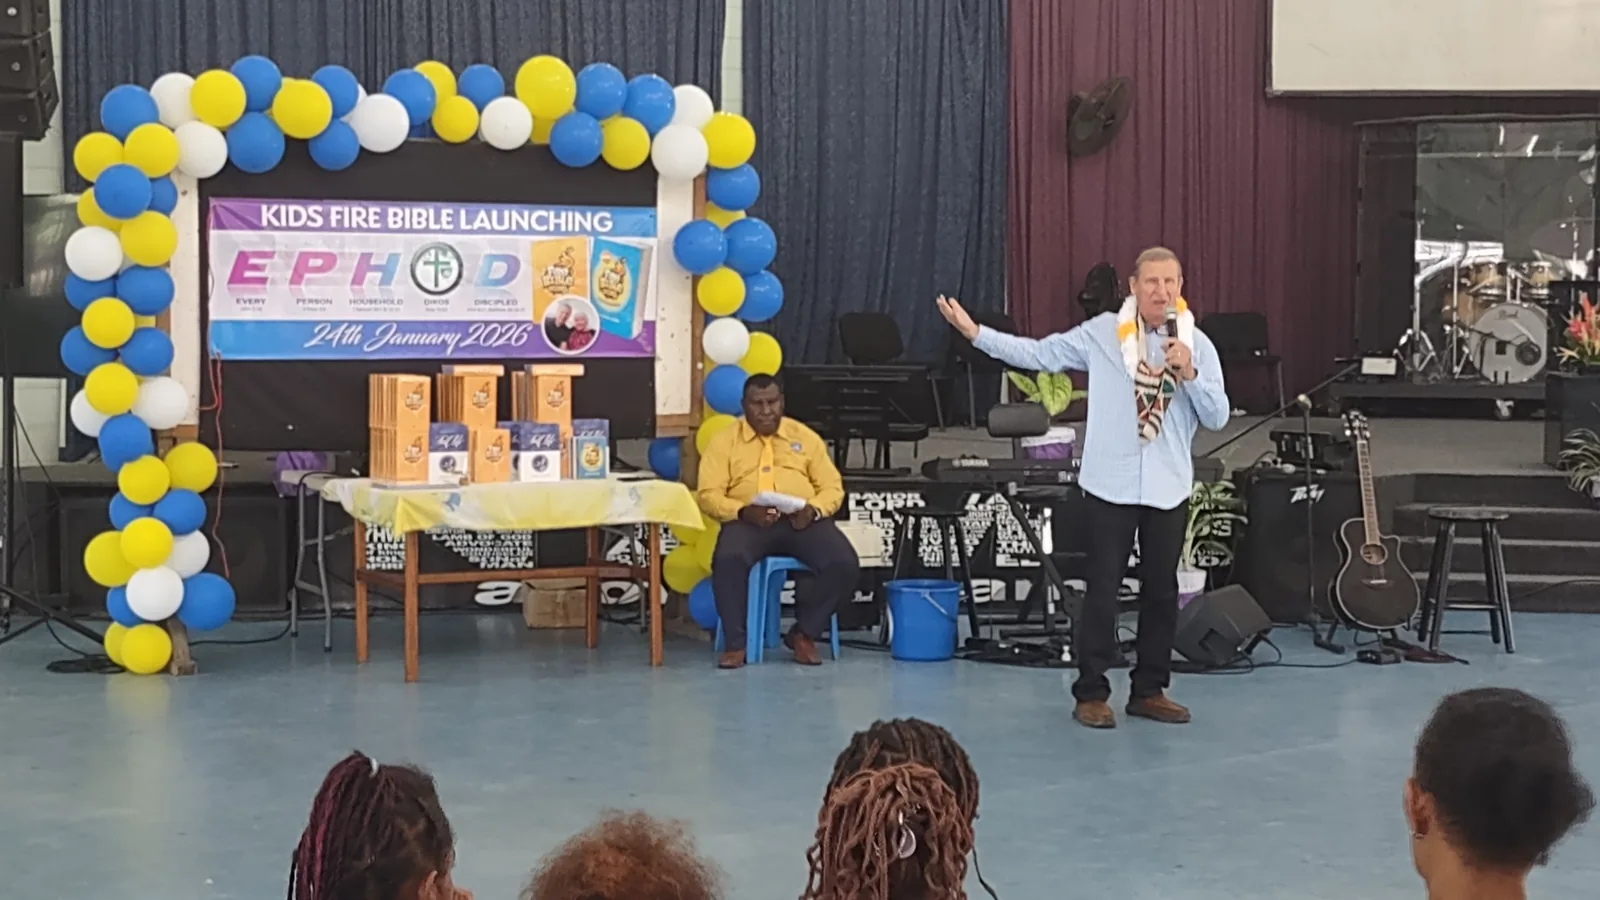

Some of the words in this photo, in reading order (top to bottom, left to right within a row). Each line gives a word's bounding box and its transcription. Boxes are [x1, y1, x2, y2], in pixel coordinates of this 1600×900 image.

[261, 204, 324, 228] KIDS
[330, 206, 381, 229] FIRE
[387, 207, 454, 230] BIBLE
[460, 209, 614, 233] LAUNCHING
[303, 322, 364, 348] 24th
[363, 321, 462, 356] January
[459, 322, 533, 348] 2026
